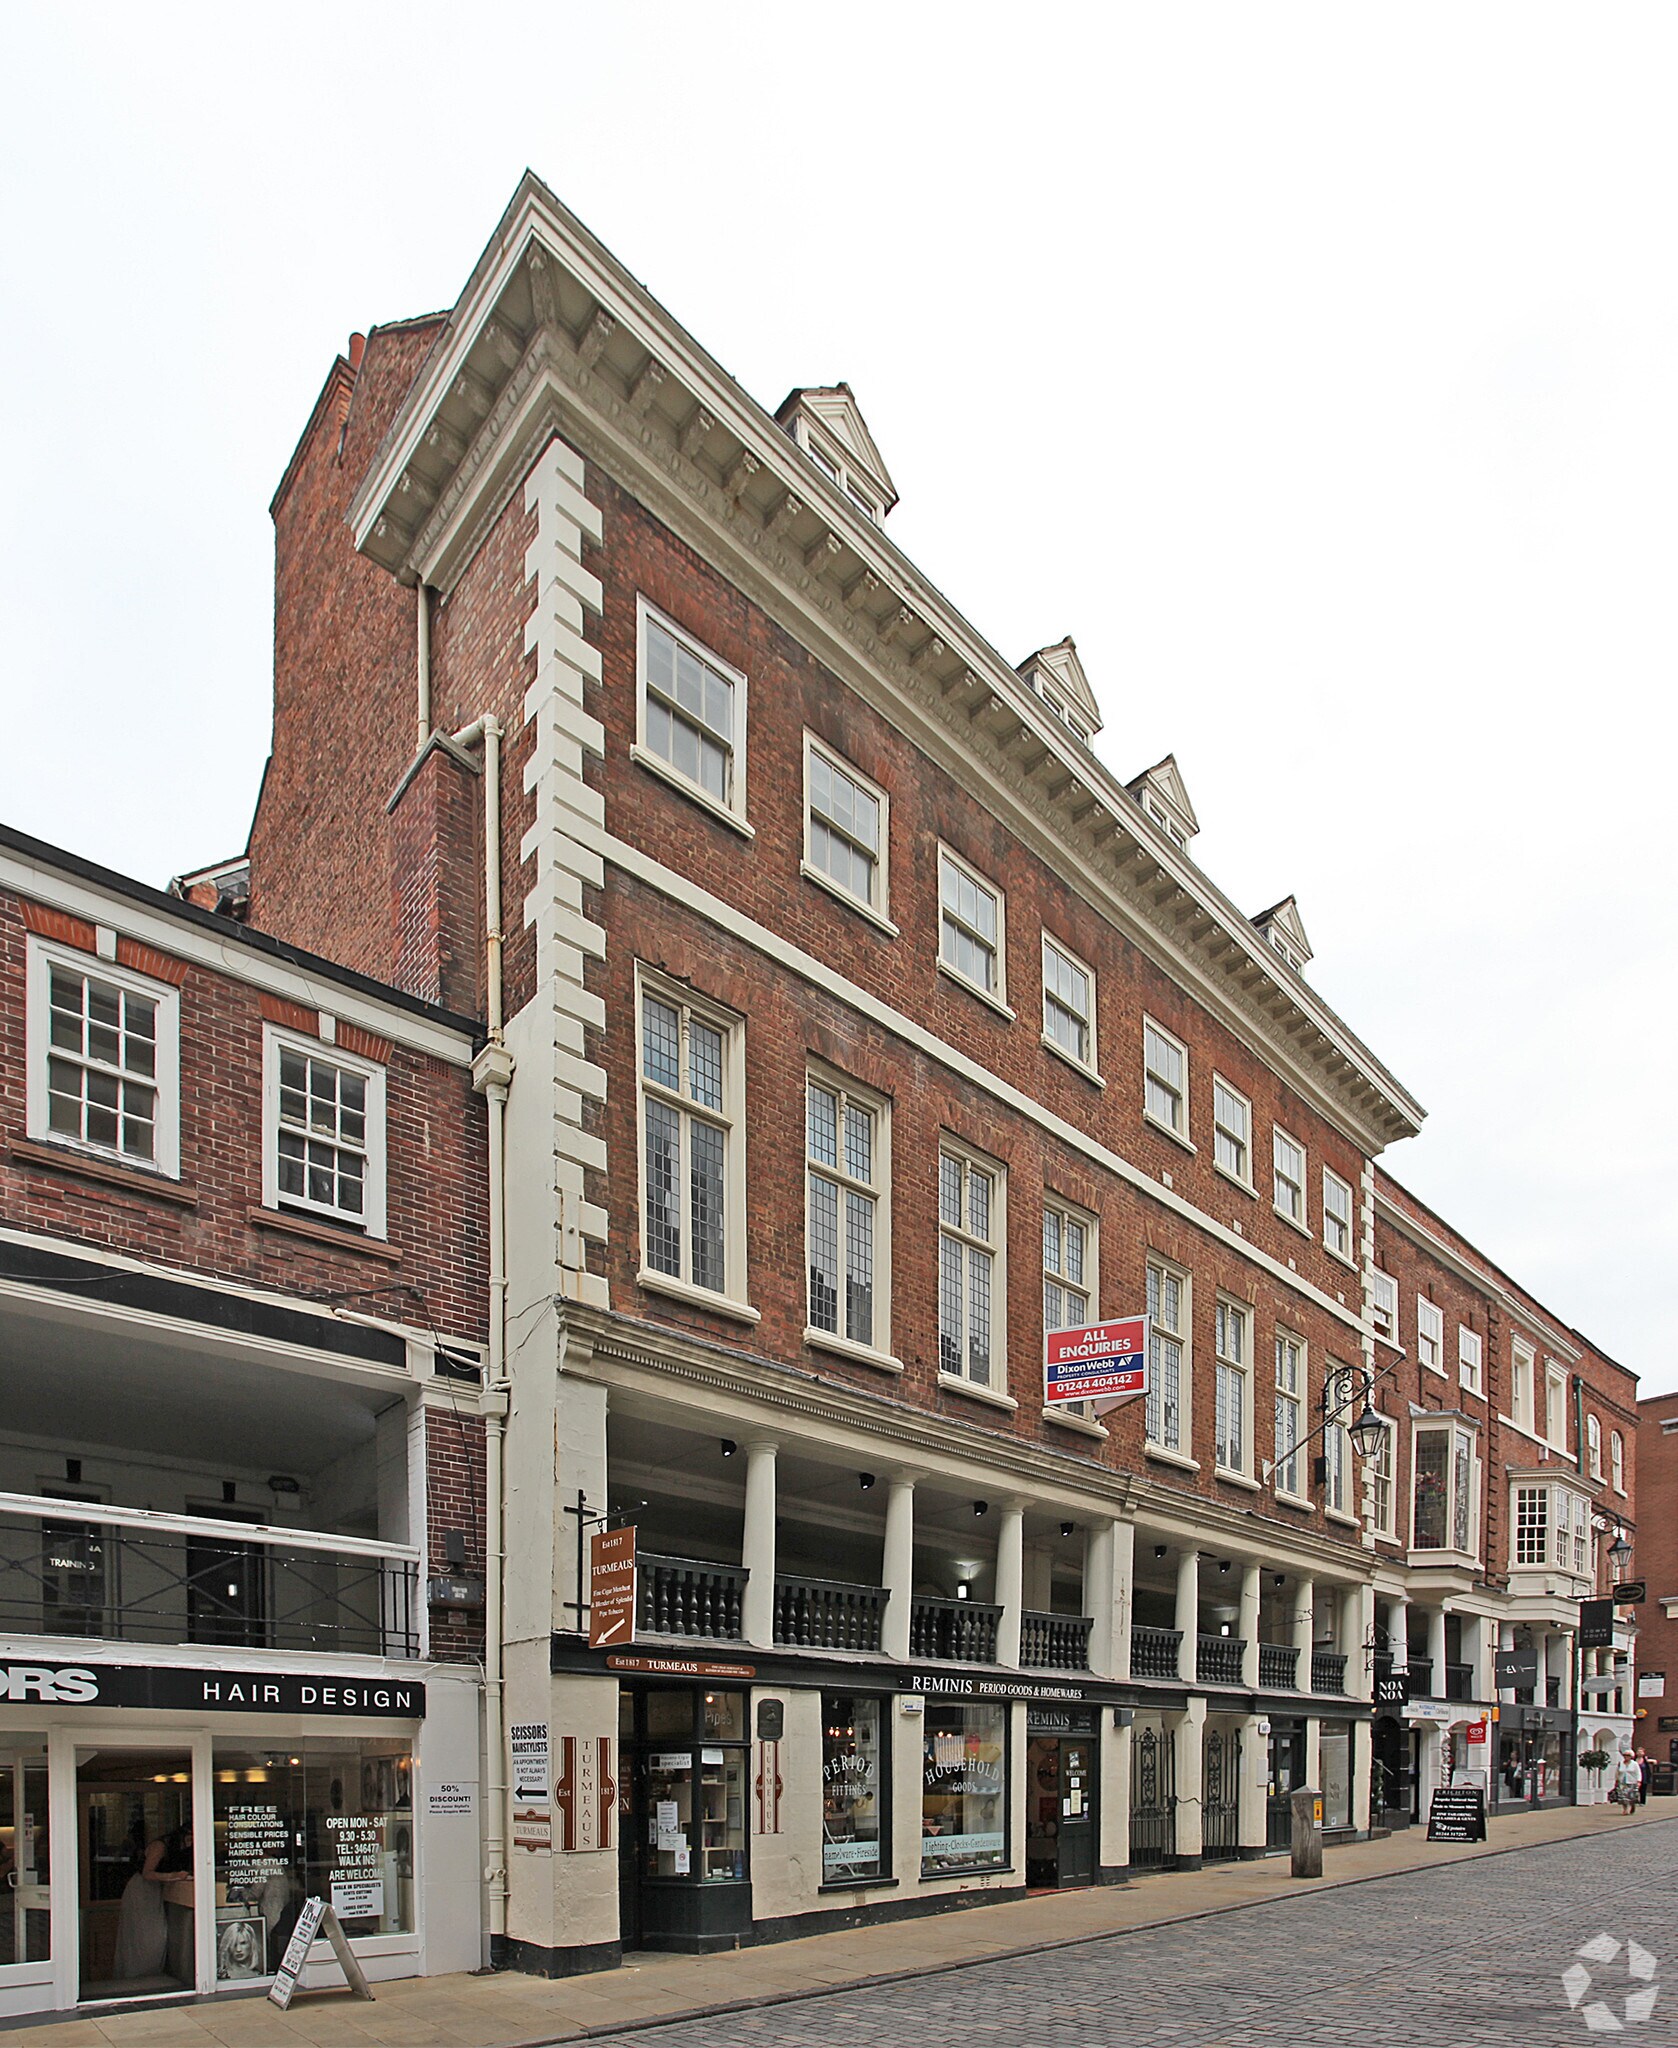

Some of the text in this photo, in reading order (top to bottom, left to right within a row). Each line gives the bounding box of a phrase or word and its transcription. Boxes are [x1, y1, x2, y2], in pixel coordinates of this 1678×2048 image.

[1082, 1329, 1108, 1343] ALL
[1059, 1338, 1131, 1359] ENQUIRIES
[1057, 1368, 1115, 1380] PROPERTY CONSULTANTS
[1056, 1374, 1133, 1392] 01244 404142
[1064, 1384, 1126, 1397] www.dixonwebb.com
[602, 1537, 623, 1549] Est 1817
[592, 1558, 633, 1576] TURMEAUS
[601, 1588, 613, 1596] Cigar
[612, 1584, 631, 1593] Merchant
[615, 1594, 633, 1604] Splendid
[598, 1610, 608, 1618] Pipe
[615, 1657, 625, 1666] Est
[625, 1658, 640, 1667] 1817
[647, 1659, 698, 1673] TURMEAUS
[912, 1675, 1082, 1699] REMINIS PERIOD GOODS & HOMEWARES
[1379, 1680, 1404, 1690] NOA
[203, 1682, 280, 1703] HAIR
[301, 1686, 411, 1708] DESIGN
[1379, 1690, 1404, 1700] NOA
[705, 1711, 732, 1727] Pipes
[1027, 1710, 1070, 1727] REMINIS
[511, 1724, 548, 1740] SCISSORS
[512, 1742, 548, 1753] HAIRSTYLISTS
[519, 1758, 548, 1766] APPOINTMENT
[661, 1759, 690, 1767] specialist
[823, 1754, 875, 1781] PERIOD
[925, 1757, 1001, 1785] HOUSEHOLD
[1065, 1769, 1088, 1777] WELCOME
[441, 1784, 459, 1793] 50%
[558, 1787, 614, 1797] Est 1817
[581, 1741, 593, 1845] TURMEAUS
[831, 1783, 867, 1796] FITTINGS
[952, 1781, 976, 1793] GOODS
[429, 1795, 471, 1803] DISCOUNT!
[228, 1805, 278, 1813] FREE
[247, 1813, 277, 1821] COLOUR
[326, 1817, 348, 1829] OPEN
[349, 1817, 368, 1828] MON
[373, 1817, 389, 1828] SAT
[228, 1820, 284, 1829] CONSULTATIONS
[515, 1825, 549, 1836] TURMEAUS
[229, 1830, 289, 1839] SENSIBLE PRICES
[339, 1831, 355, 1842] 9.30
[360, 1830, 376, 1841] 5.30
[229, 1841, 254, 1849] LADIES
[335, 1843, 380, 1855] TEL: 346477
[228, 1849, 264, 1857] HAIRCUTS
[229, 1858, 289, 1867] TOTAL RE-STYLES
[338, 1855, 376, 1867] WALK INS
[229, 1868, 284, 1877] QUALITY RETAIL
[328, 1868, 385, 1881] ARE WELCOME
[229, 1876, 267, 1885] PRODUCTS
